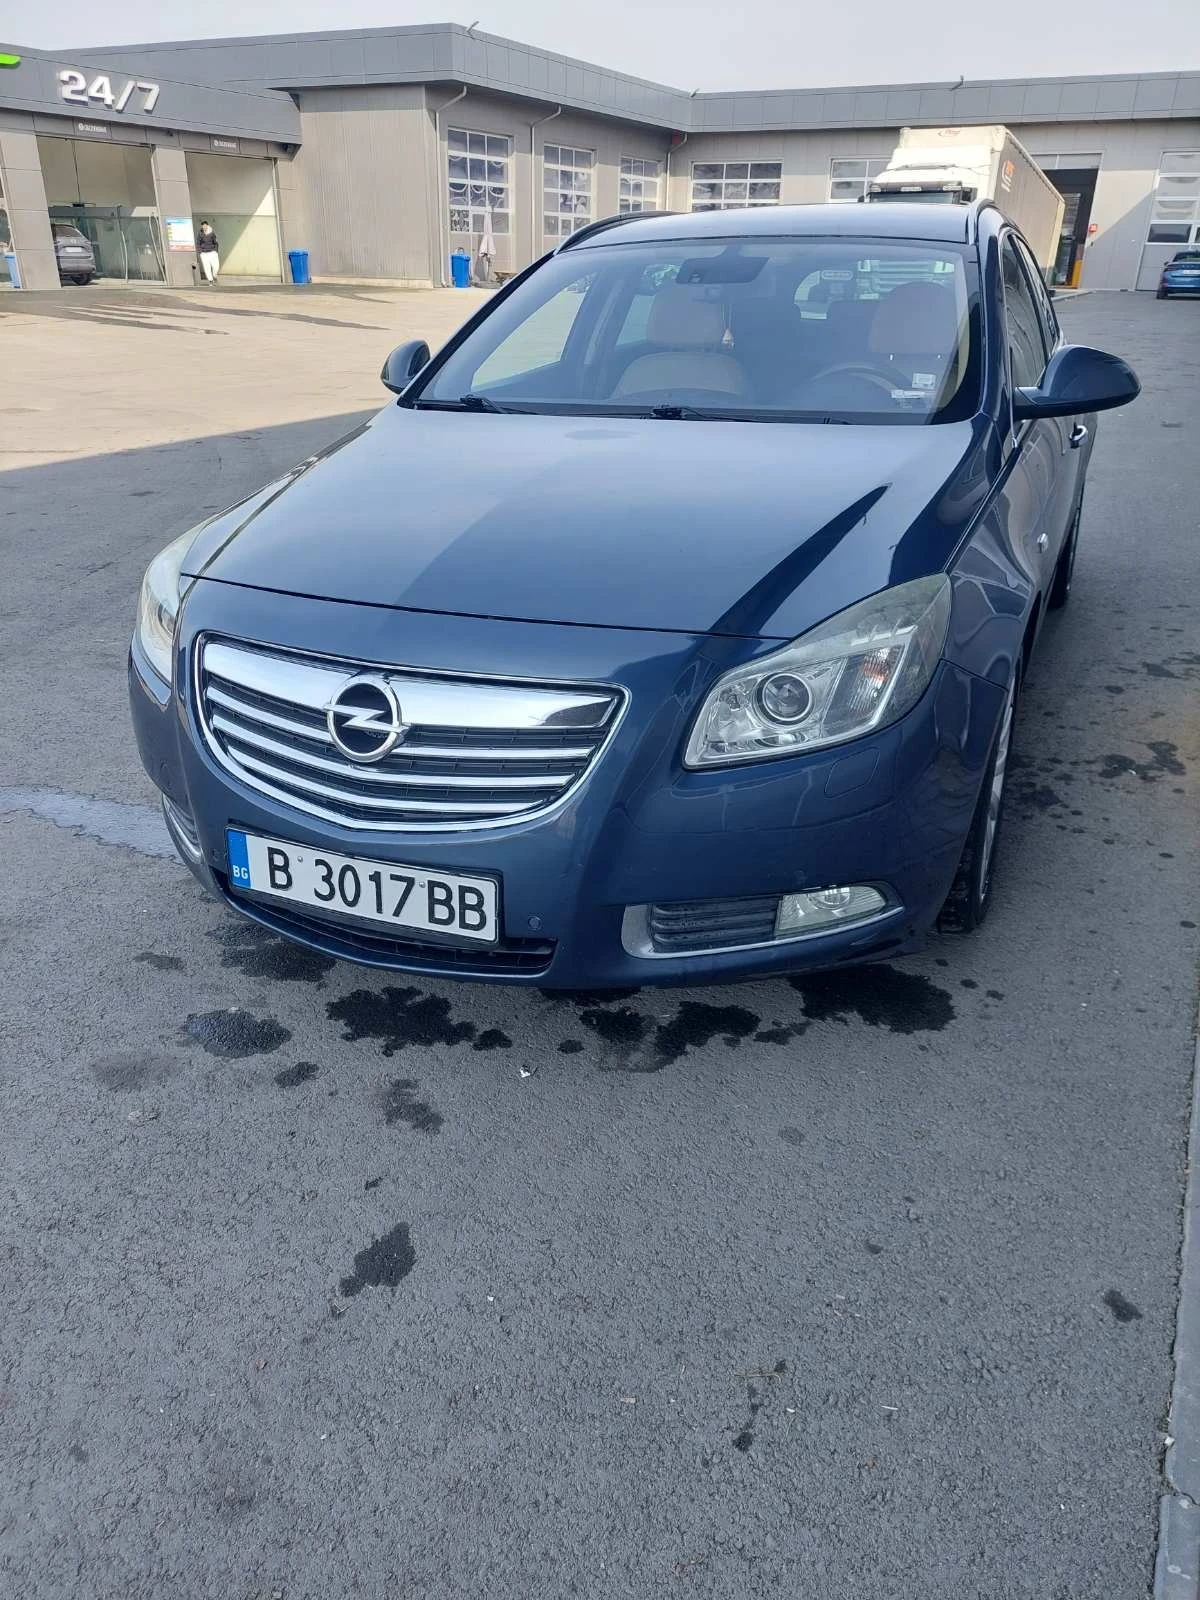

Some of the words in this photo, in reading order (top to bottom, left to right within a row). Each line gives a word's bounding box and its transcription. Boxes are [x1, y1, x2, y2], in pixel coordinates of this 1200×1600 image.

[59, 69, 160, 114] 24/7
[232, 865, 249, 880] BG
[267, 846, 293, 891] B
[313, 858, 416, 918] 3017
[427, 880, 487, 932] BB
